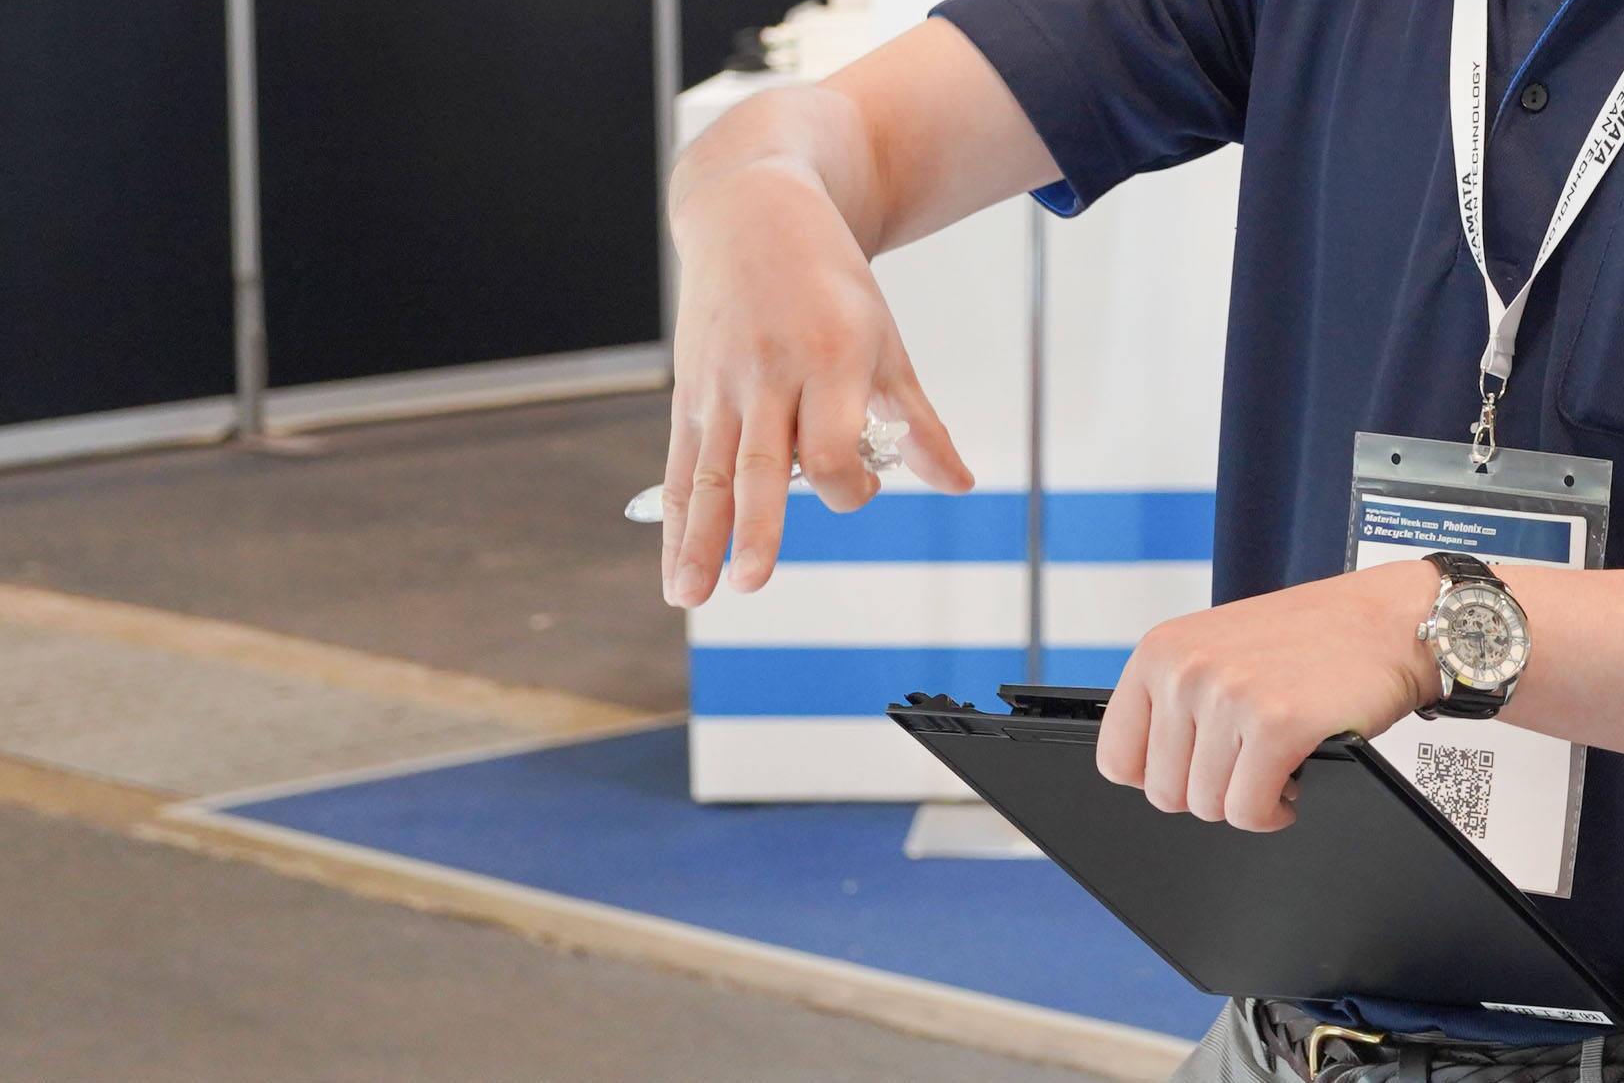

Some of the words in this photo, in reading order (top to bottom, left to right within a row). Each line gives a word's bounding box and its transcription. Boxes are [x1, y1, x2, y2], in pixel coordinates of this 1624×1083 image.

[1472, 61, 1481, 189] TECHNOLOGY
[1365, 514, 1400, 525] Material
[1400, 517, 1421, 527] Week
[1443, 520, 1482, 534] Photonix
[1374, 526, 1414, 539] Recycle
[1415, 530, 1436, 541] Tech
[1437, 533, 1462, 545] Japan
